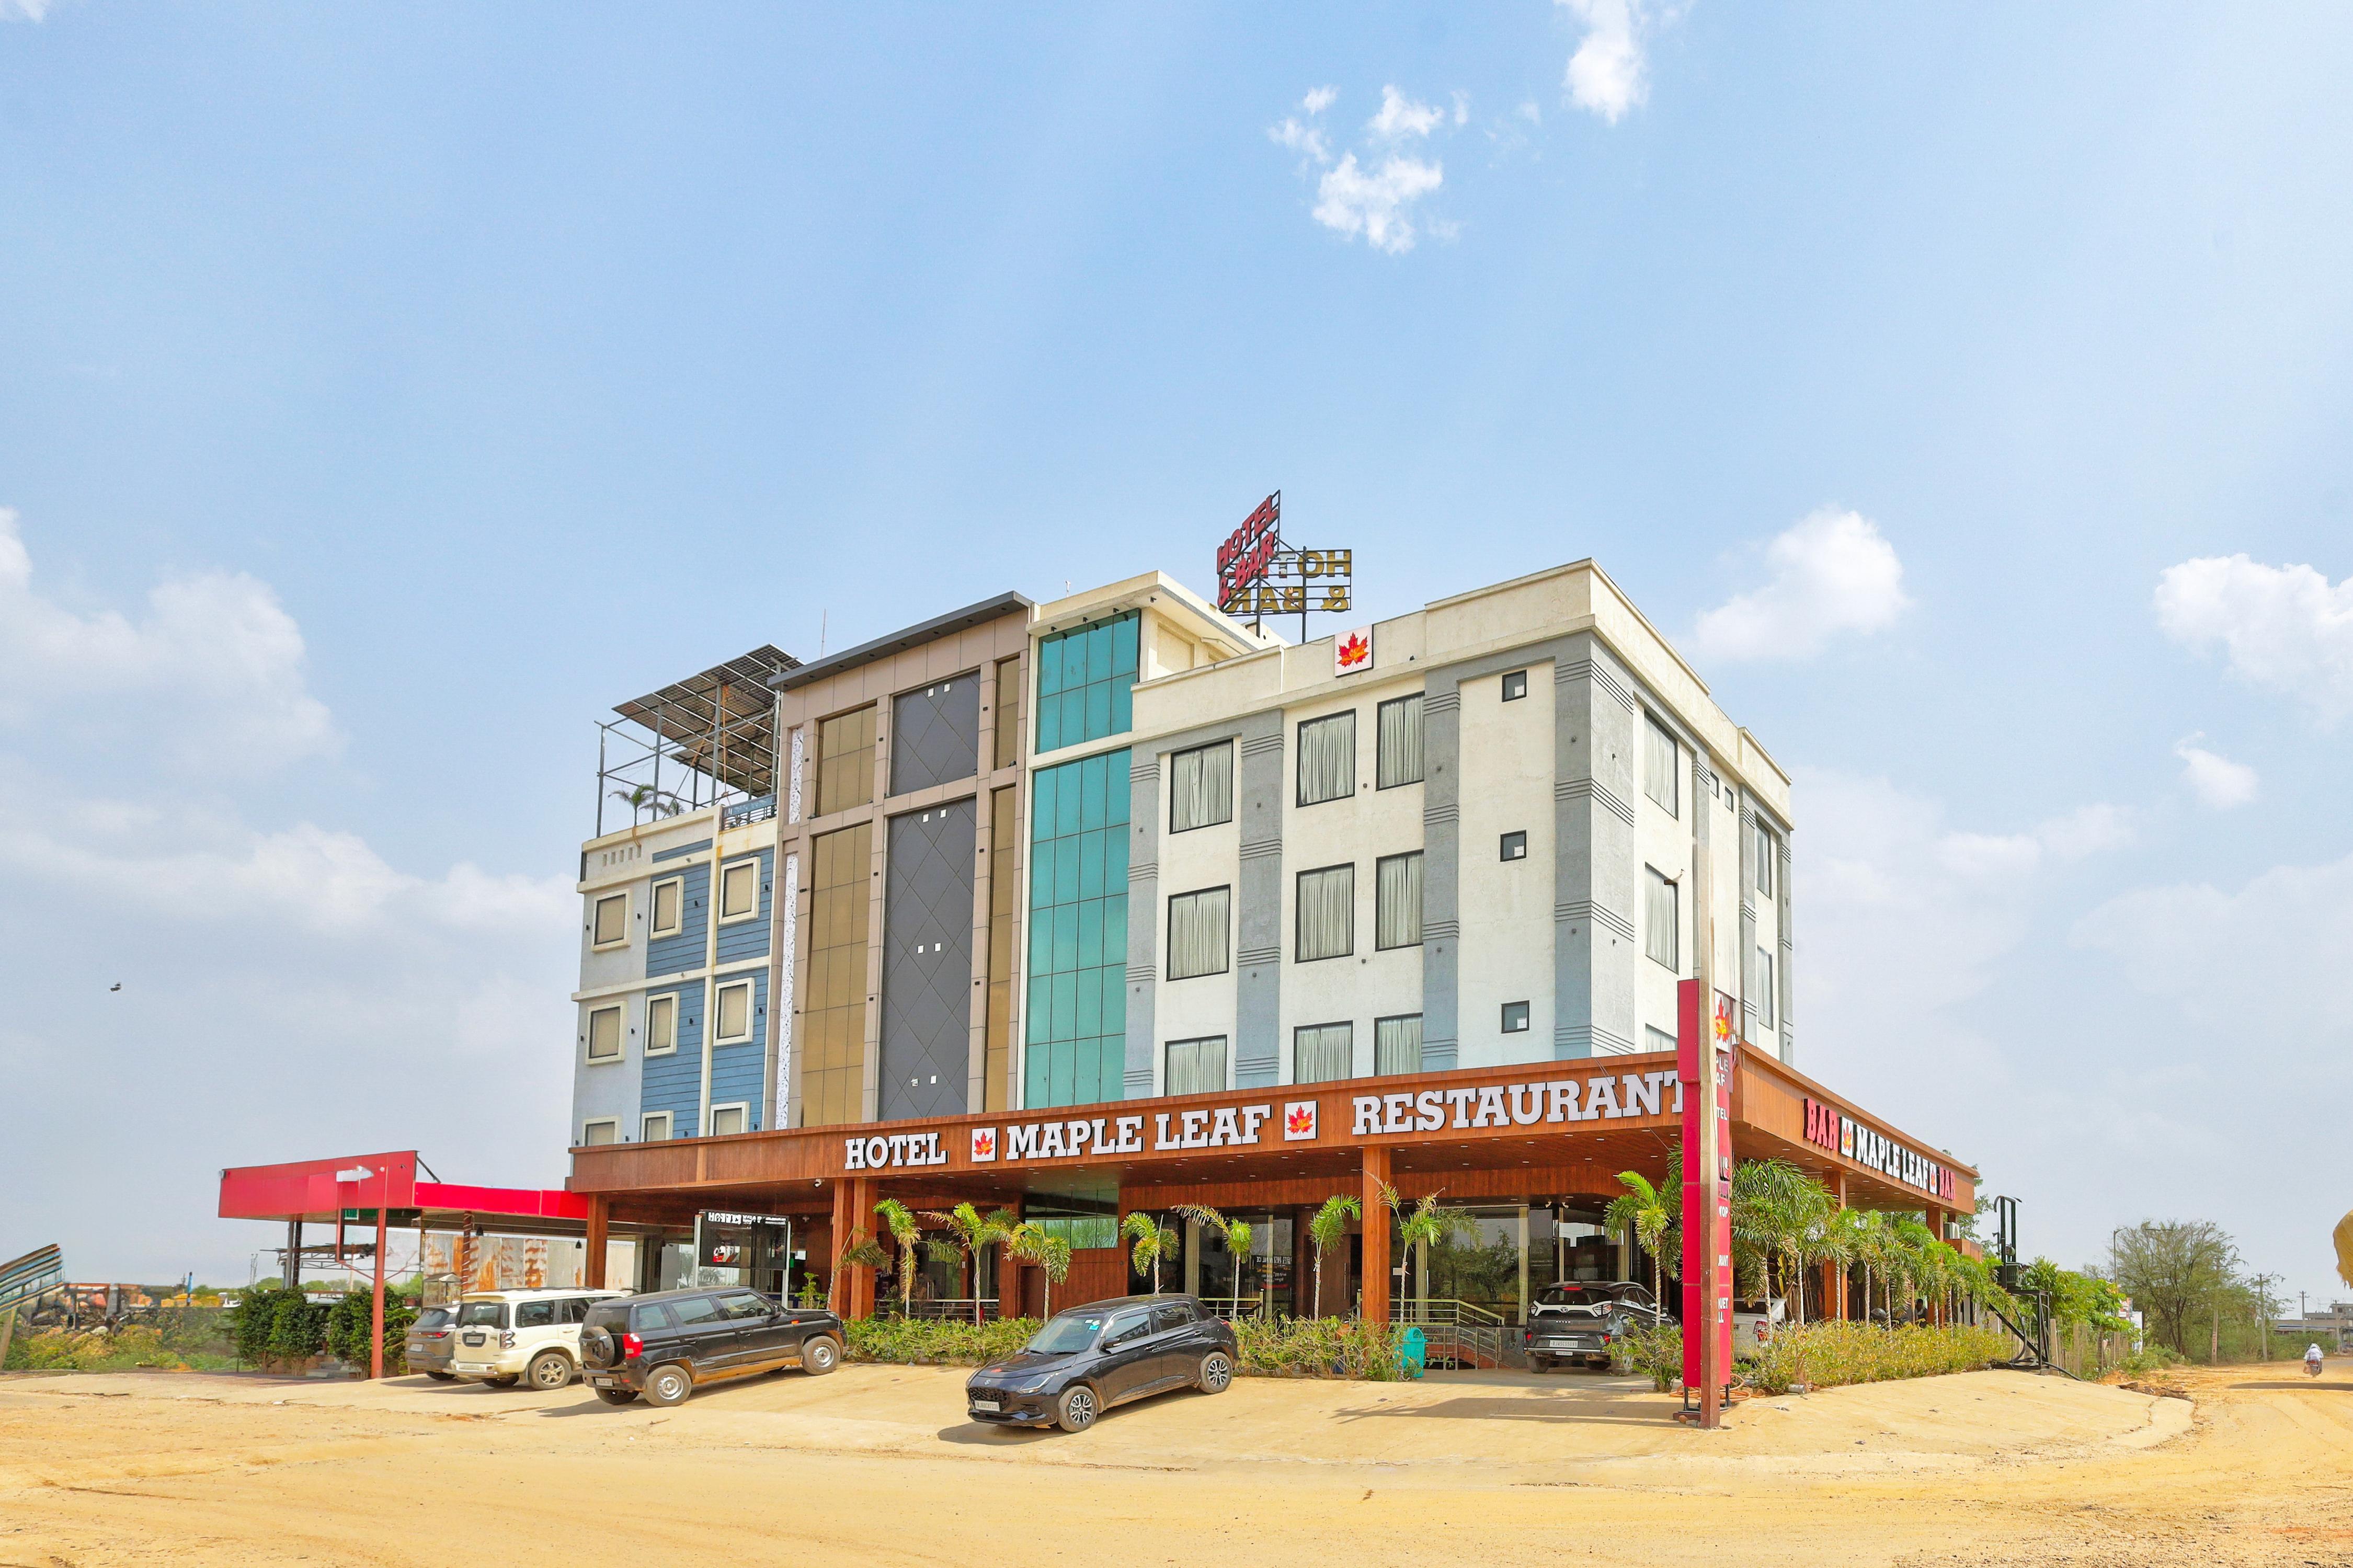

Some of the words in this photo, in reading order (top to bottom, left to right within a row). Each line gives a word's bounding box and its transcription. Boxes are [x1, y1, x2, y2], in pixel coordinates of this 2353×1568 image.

[1217, 495, 1278, 574] HOTEL
[1235, 531, 1275, 591] BAR
[1352, 1070, 1683, 1136] RESTAURANT
[844, 1132, 947, 1170] HOTEL
[1006, 1115, 1144, 1160] MAPLE
[1155, 1104, 1272, 1150] LEAF
[1804, 1098, 1839, 1151] BAR
[1855, 1124, 1901, 1178] MAPLE
[1902, 1147, 1929, 1191] LEAF
[1939, 1167, 1956, 1200] BAR
